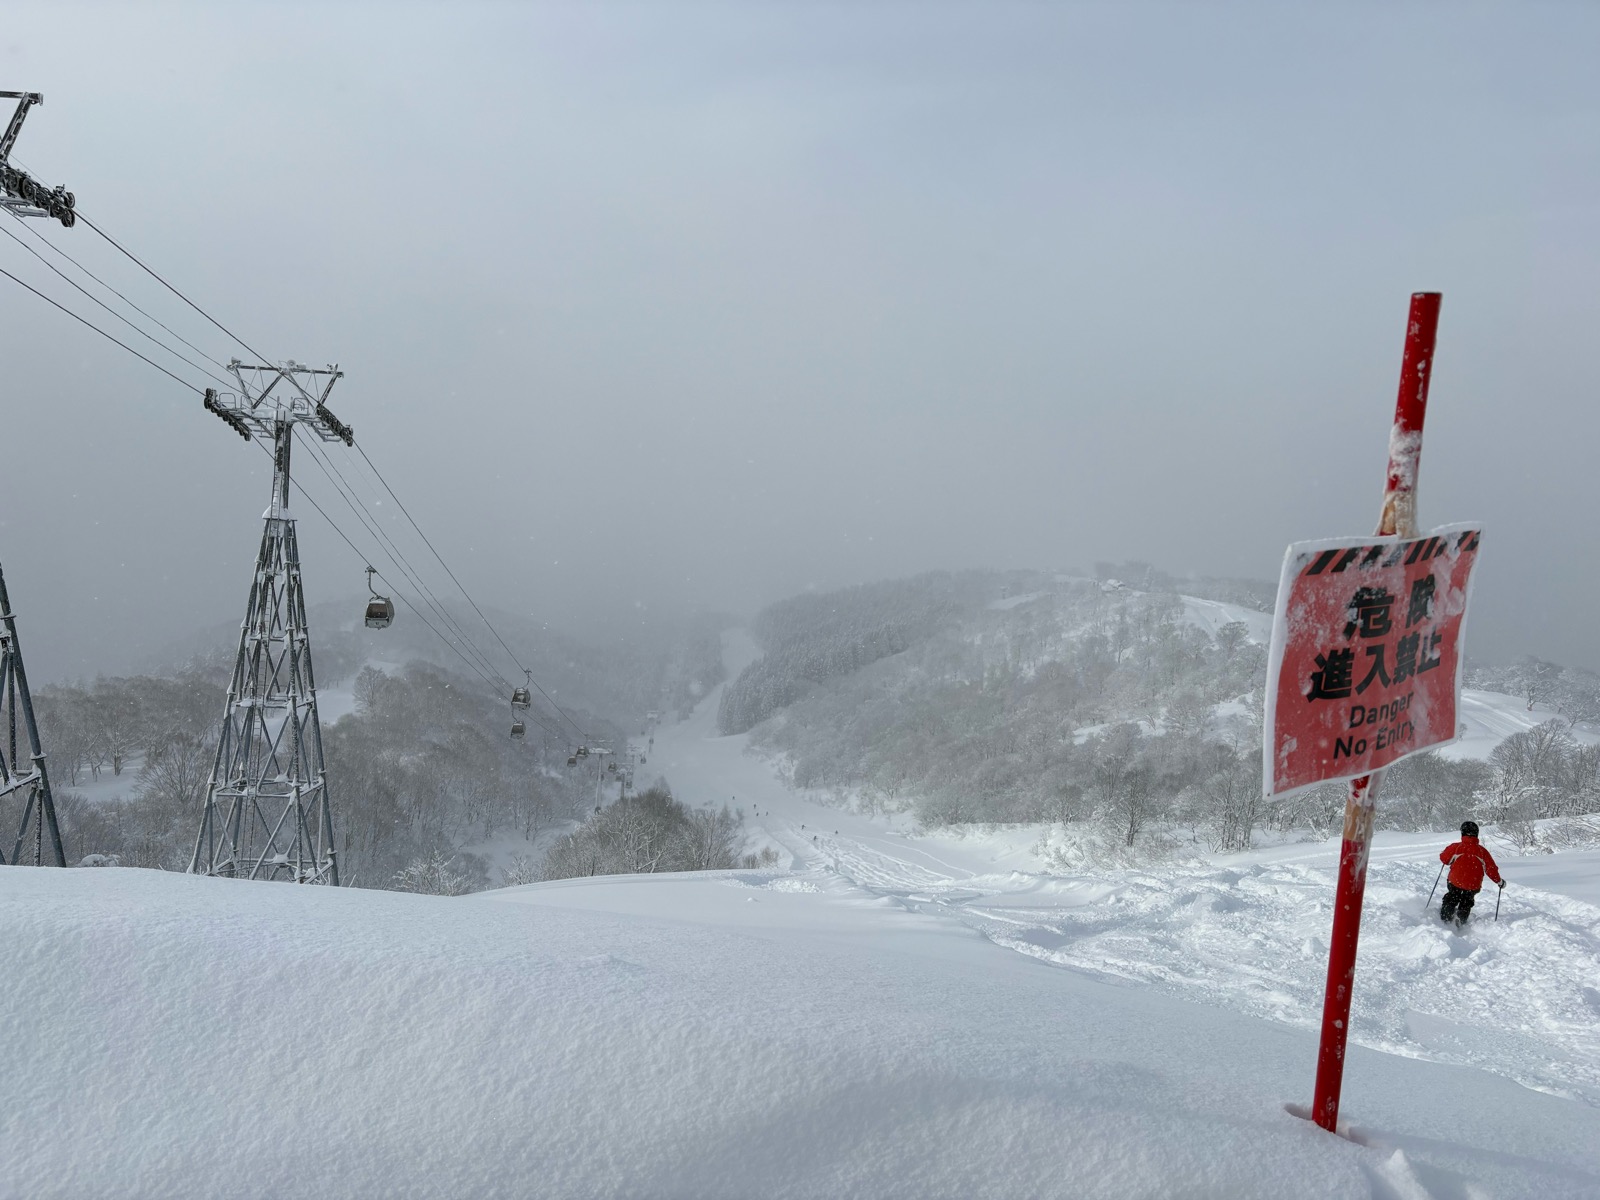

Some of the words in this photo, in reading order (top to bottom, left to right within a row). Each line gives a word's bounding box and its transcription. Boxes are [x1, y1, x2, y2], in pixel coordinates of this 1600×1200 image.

[1306, 627, 1442, 703] 進入禁止
[1348, 691, 1415, 729] Danger
[1333, 735, 1367, 760] No
[1375, 720, 1415, 751] Entry
